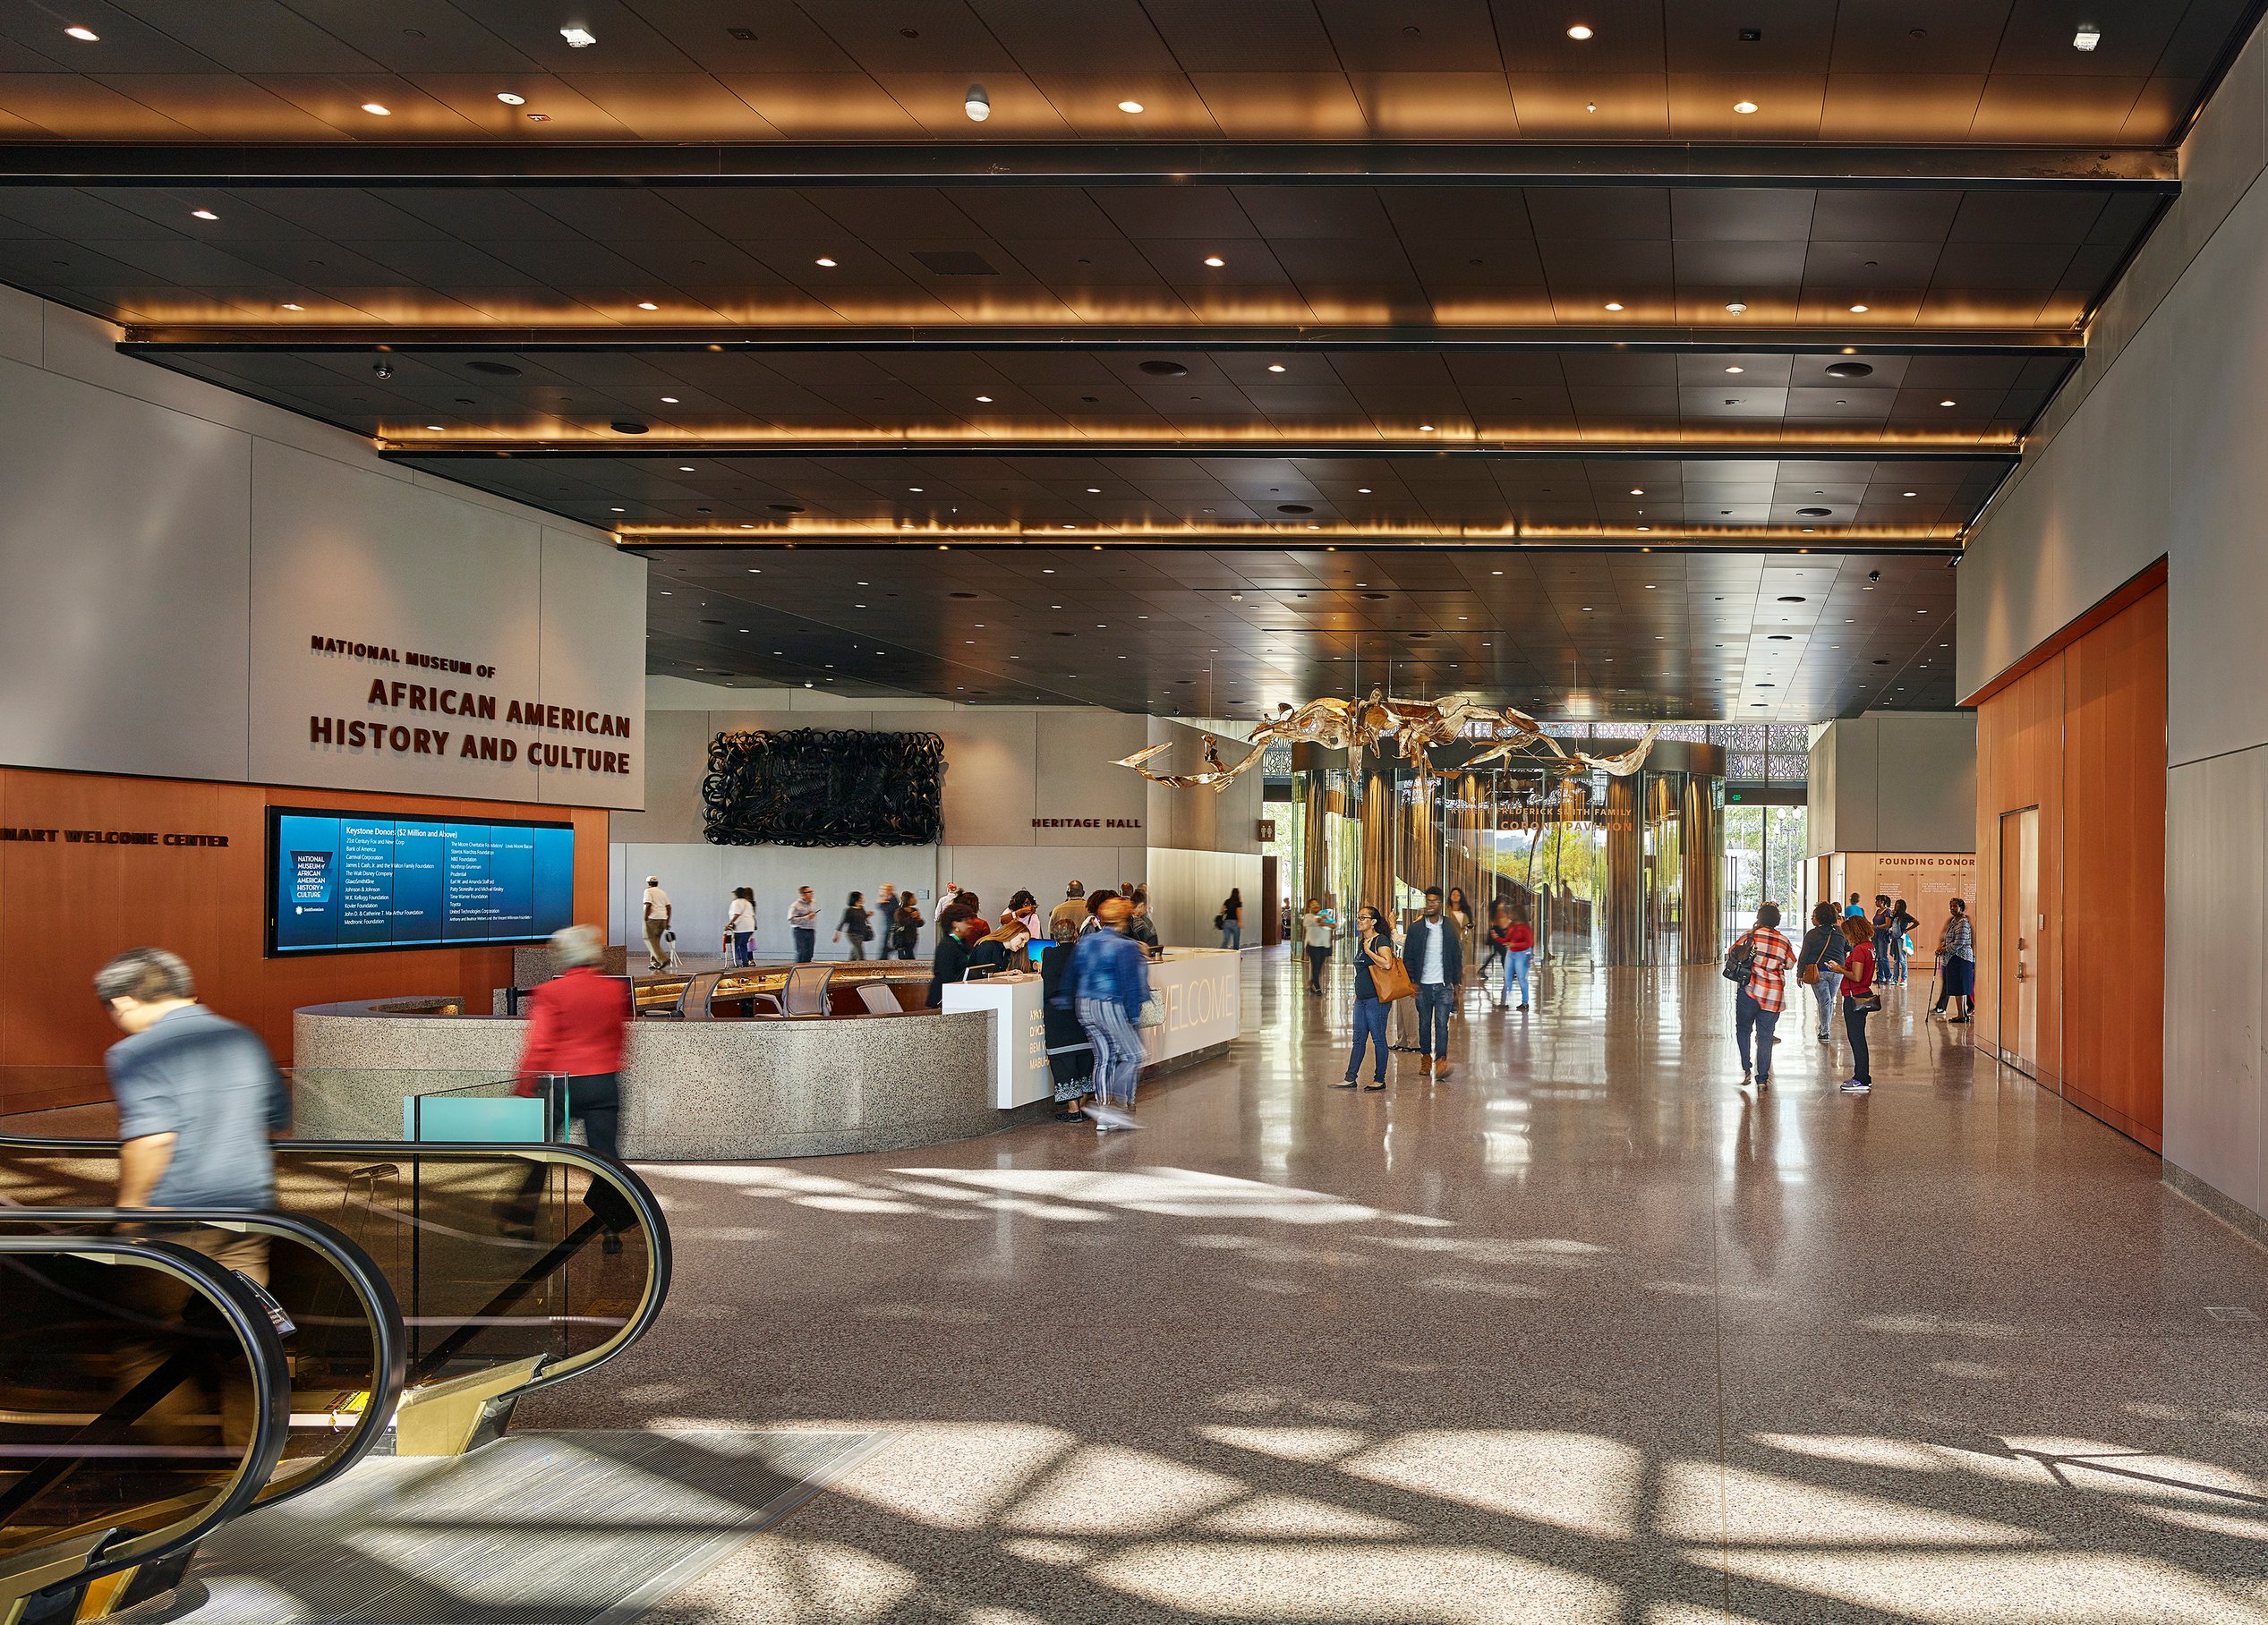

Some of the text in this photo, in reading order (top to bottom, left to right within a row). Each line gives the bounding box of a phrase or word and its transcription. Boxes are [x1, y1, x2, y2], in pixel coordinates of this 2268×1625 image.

[311, 635, 496, 679] NATIONAL MUSEUM OF
[368, 679, 630, 737] AFRICAN AMERICAN
[310, 716, 630, 774] HISTORY AND CULTURE
[1032, 818, 1141, 828] HERITAGE HALL
[1501, 821, 1632, 832] CORONA PAVILION
[64, 830, 158, 844] WELCOME
[163, 834, 229, 847] CENTER
[346, 827, 373, 836] Keystone
[1030, 1042, 1040, 1054] BEM
[1030, 1056, 1049, 1070] MABUH
